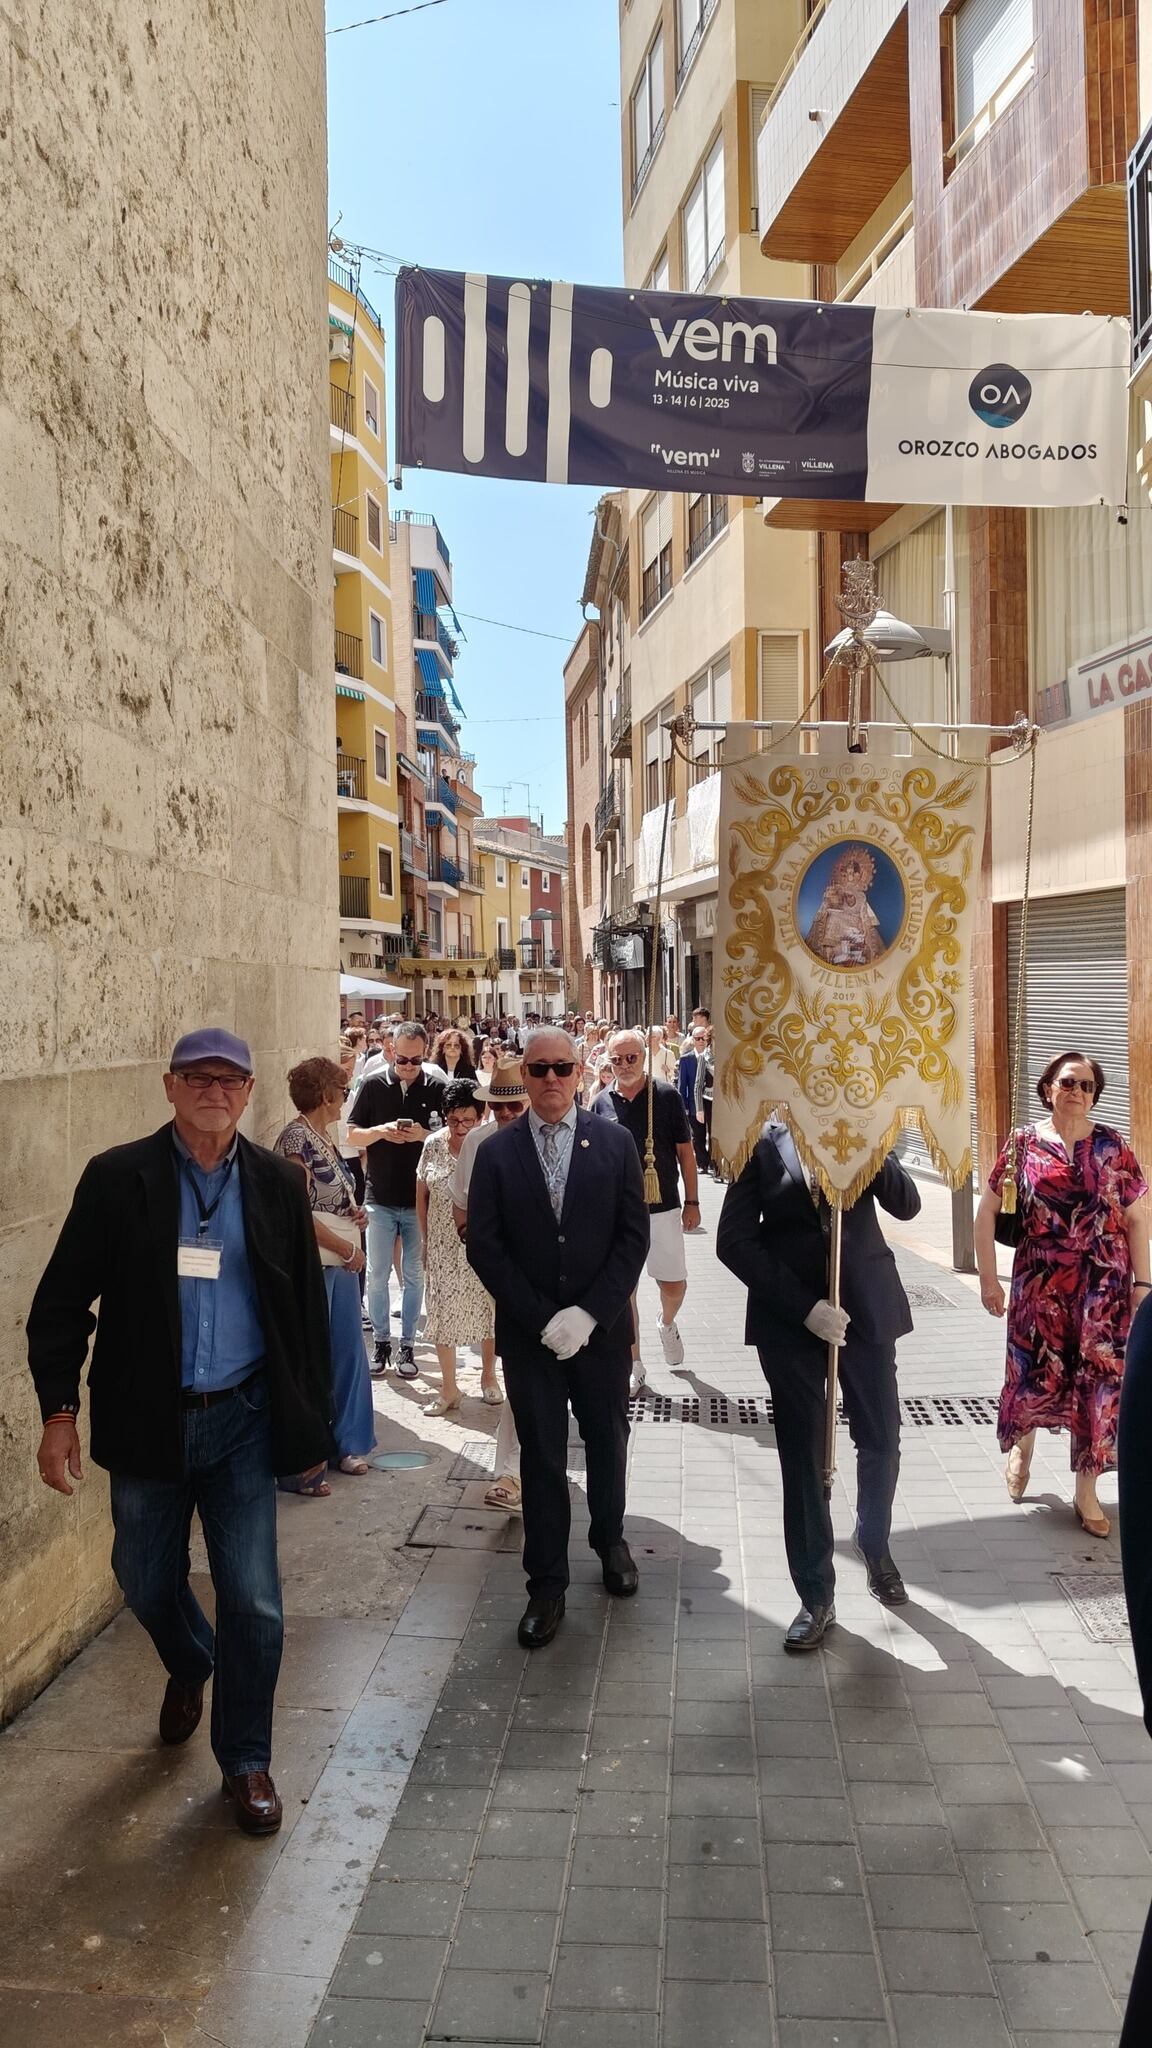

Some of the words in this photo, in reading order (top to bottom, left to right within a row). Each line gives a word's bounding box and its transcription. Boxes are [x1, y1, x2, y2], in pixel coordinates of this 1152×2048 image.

[650, 318, 777, 365] vem
[655, 369, 718, 391] Música
[723, 375, 759, 393] viva
[705, 398, 730, 409] 2025
[898, 440, 979, 458] OROZCO
[985, 443, 1097, 460] ABOGADOS
[759, 463, 786, 471] VILLENA
[801, 461, 835, 470] VILLENA
[1087, 671, 1115, 710] LA
[1118, 652, 1152, 697] CA
[867, 822, 889, 842] DE
[889, 836, 916, 868] LAS
[900, 869, 924, 954] VIRTUDES
[810, 963, 885, 989] VILLENA
